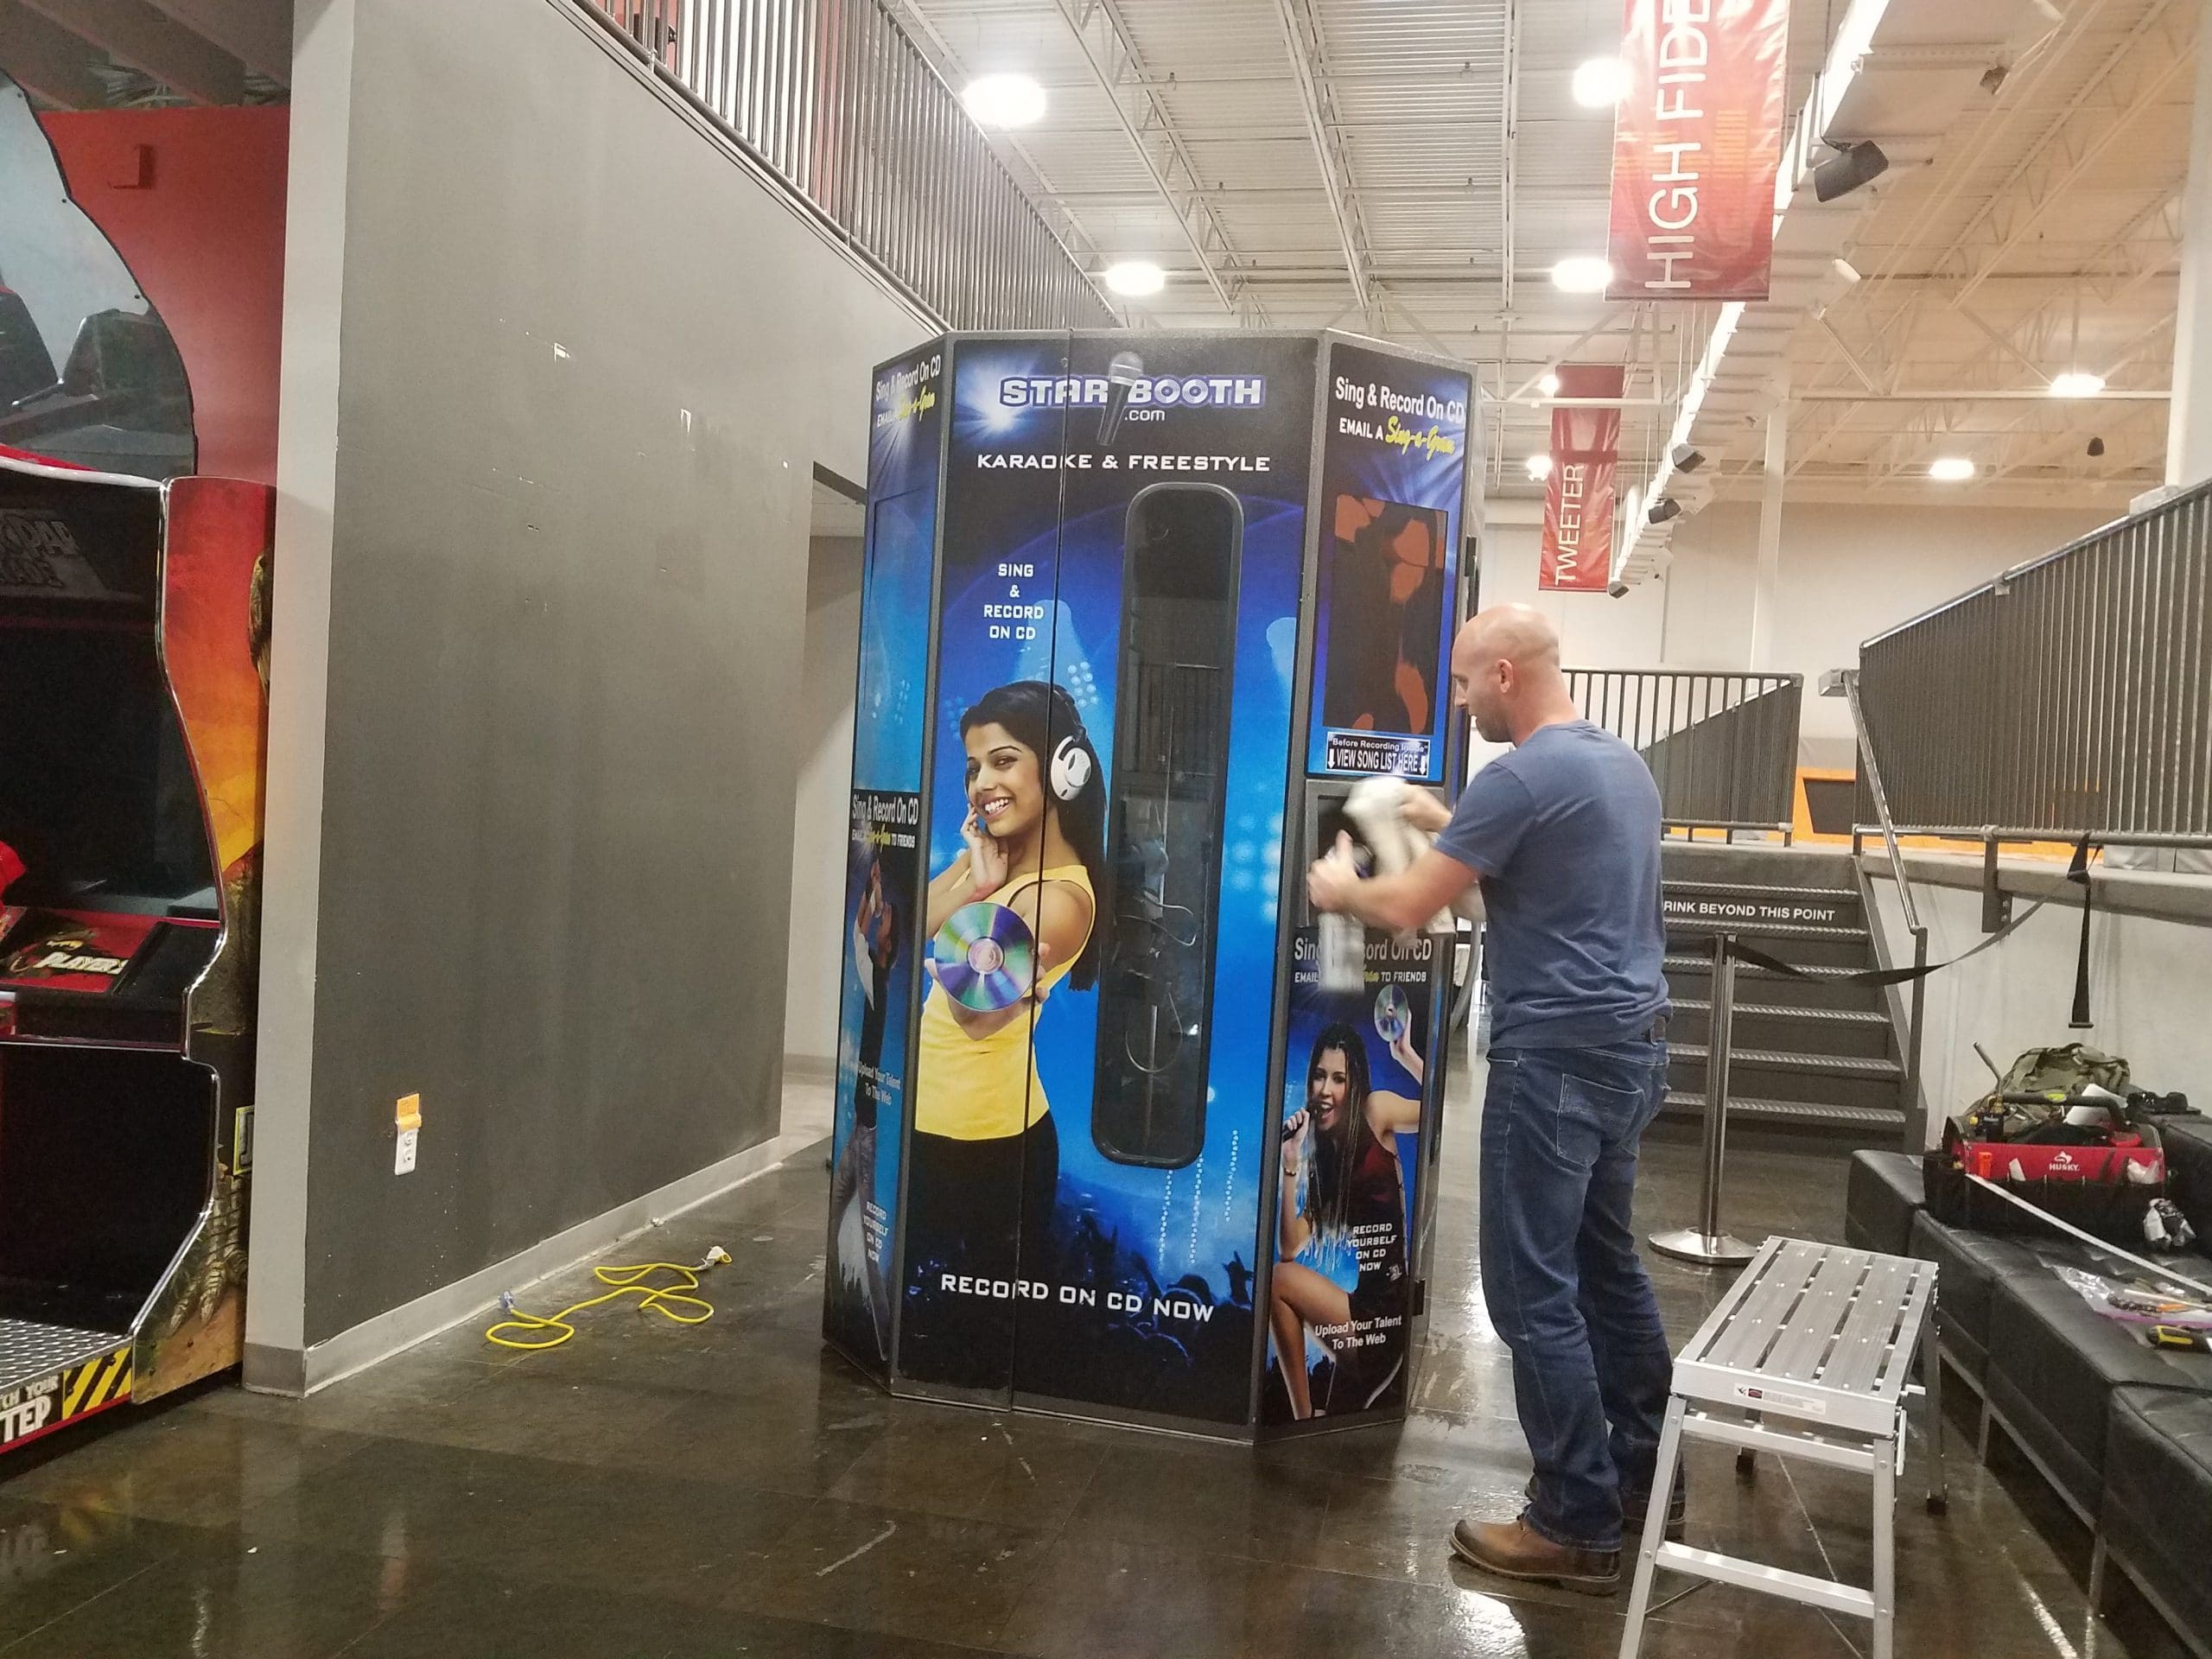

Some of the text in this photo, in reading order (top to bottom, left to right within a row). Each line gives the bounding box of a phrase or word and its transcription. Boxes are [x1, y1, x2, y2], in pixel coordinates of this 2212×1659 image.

[1644, 143, 1701, 289] HIGH
[919, 361, 930, 383] On
[931, 354, 941, 378] CD
[1002, 378, 1262, 405] STAR BOOTH
[1335, 376, 1465, 424] Sing & Record On CD
[1339, 417, 1373, 438] EMAIL
[1375, 425, 1383, 441] A
[977, 454, 1271, 472] KARAOKE & FREESTYLE
[1554, 463, 1586, 587] TWEETER
[998, 563, 1033, 577] SING
[1009, 584, 1020, 598] &
[983, 604, 1044, 620] RECORD
[989, 625, 1036, 640] ON CD
[1332, 737, 1358, 747] Before
[1360, 741, 1400, 753] Recording
[1336, 748, 1418, 772] VIEW SONG LIST HERE
[852, 794, 919, 826] Sing & Record On CD
[1663, 900, 1836, 921] RINK BEYOND THIS POINT
[1413, 938, 1432, 961] CD
[1381, 971, 1391, 982] TO
[1393, 971, 1427, 982] FRIENDS
[2049, 1163, 2078, 1172] HUSKY
[1352, 1223, 1393, 1235] RECORD
[1347, 1235, 1397, 1248] YOURSELF
[1356, 1248, 1387, 1260] ON CD
[1359, 1261, 1382, 1272] NOW
[941, 1274, 1214, 1323] RECORD ON CD NOW
[1315, 1314, 1402, 1338] Upload Your Talent
[1332, 1332, 1386, 1350] To The Web
[0, 1375, 59, 1408] CH YOUR
[0, 1395, 52, 1444] TEP
